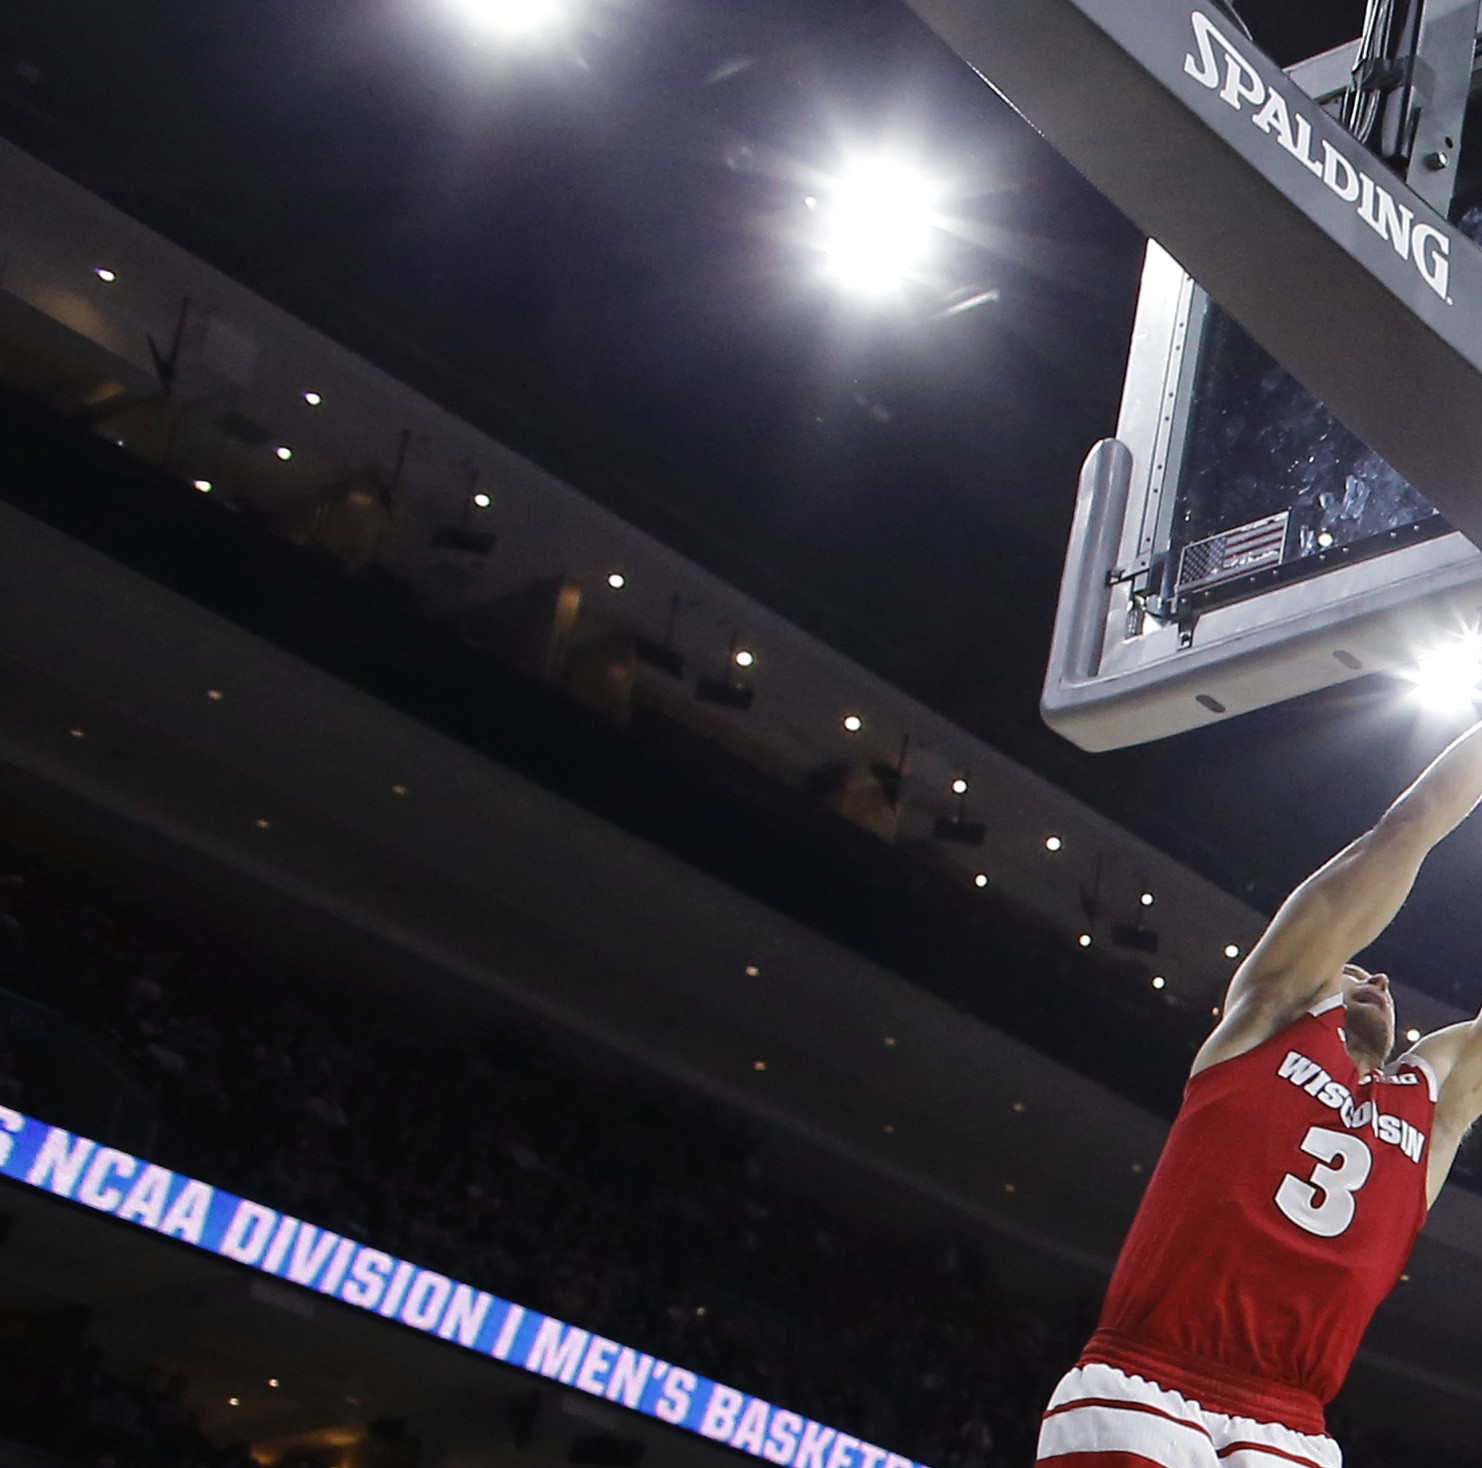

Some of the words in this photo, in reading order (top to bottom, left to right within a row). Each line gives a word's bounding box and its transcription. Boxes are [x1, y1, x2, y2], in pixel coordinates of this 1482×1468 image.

[1184, 10, 1453, 305] SPALDING
[25, 1124, 215, 1245] NCAA
[219, 1198, 492, 1350] DIVISION
[492, 1301, 526, 1361] I
[525, 1318, 698, 1426] MEN'S
[1274, 1126, 1373, 1238] 3
